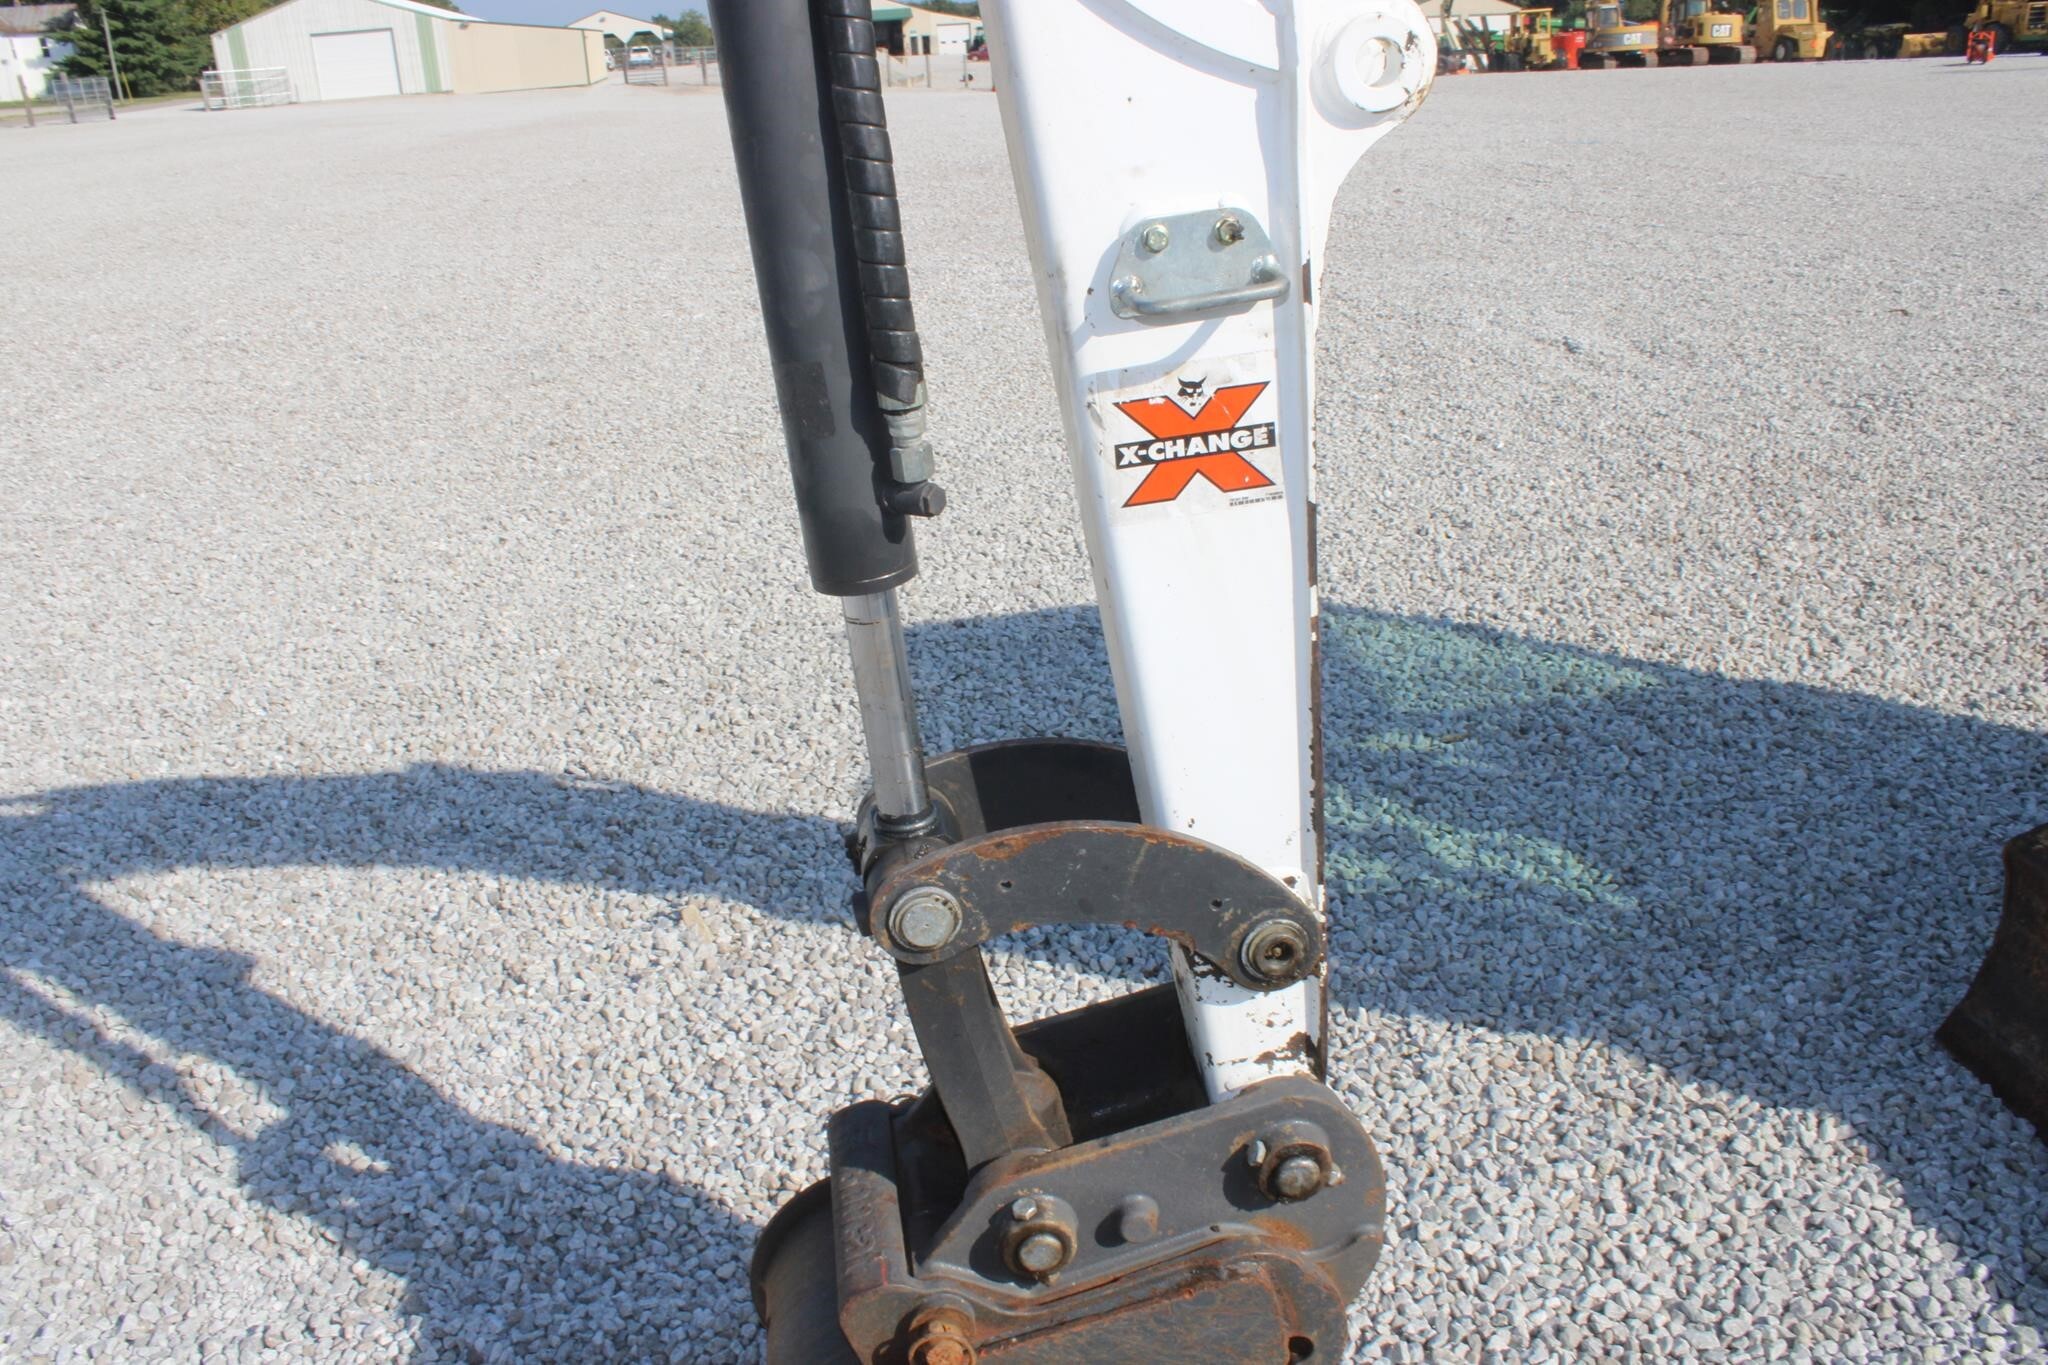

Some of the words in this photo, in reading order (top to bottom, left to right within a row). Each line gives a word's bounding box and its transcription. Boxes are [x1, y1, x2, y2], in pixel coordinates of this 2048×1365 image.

[1712, 25, 1731, 37] CAT
[1623, 33, 1642, 45] CAT
[1118, 426, 1270, 466] X-CHANGE
